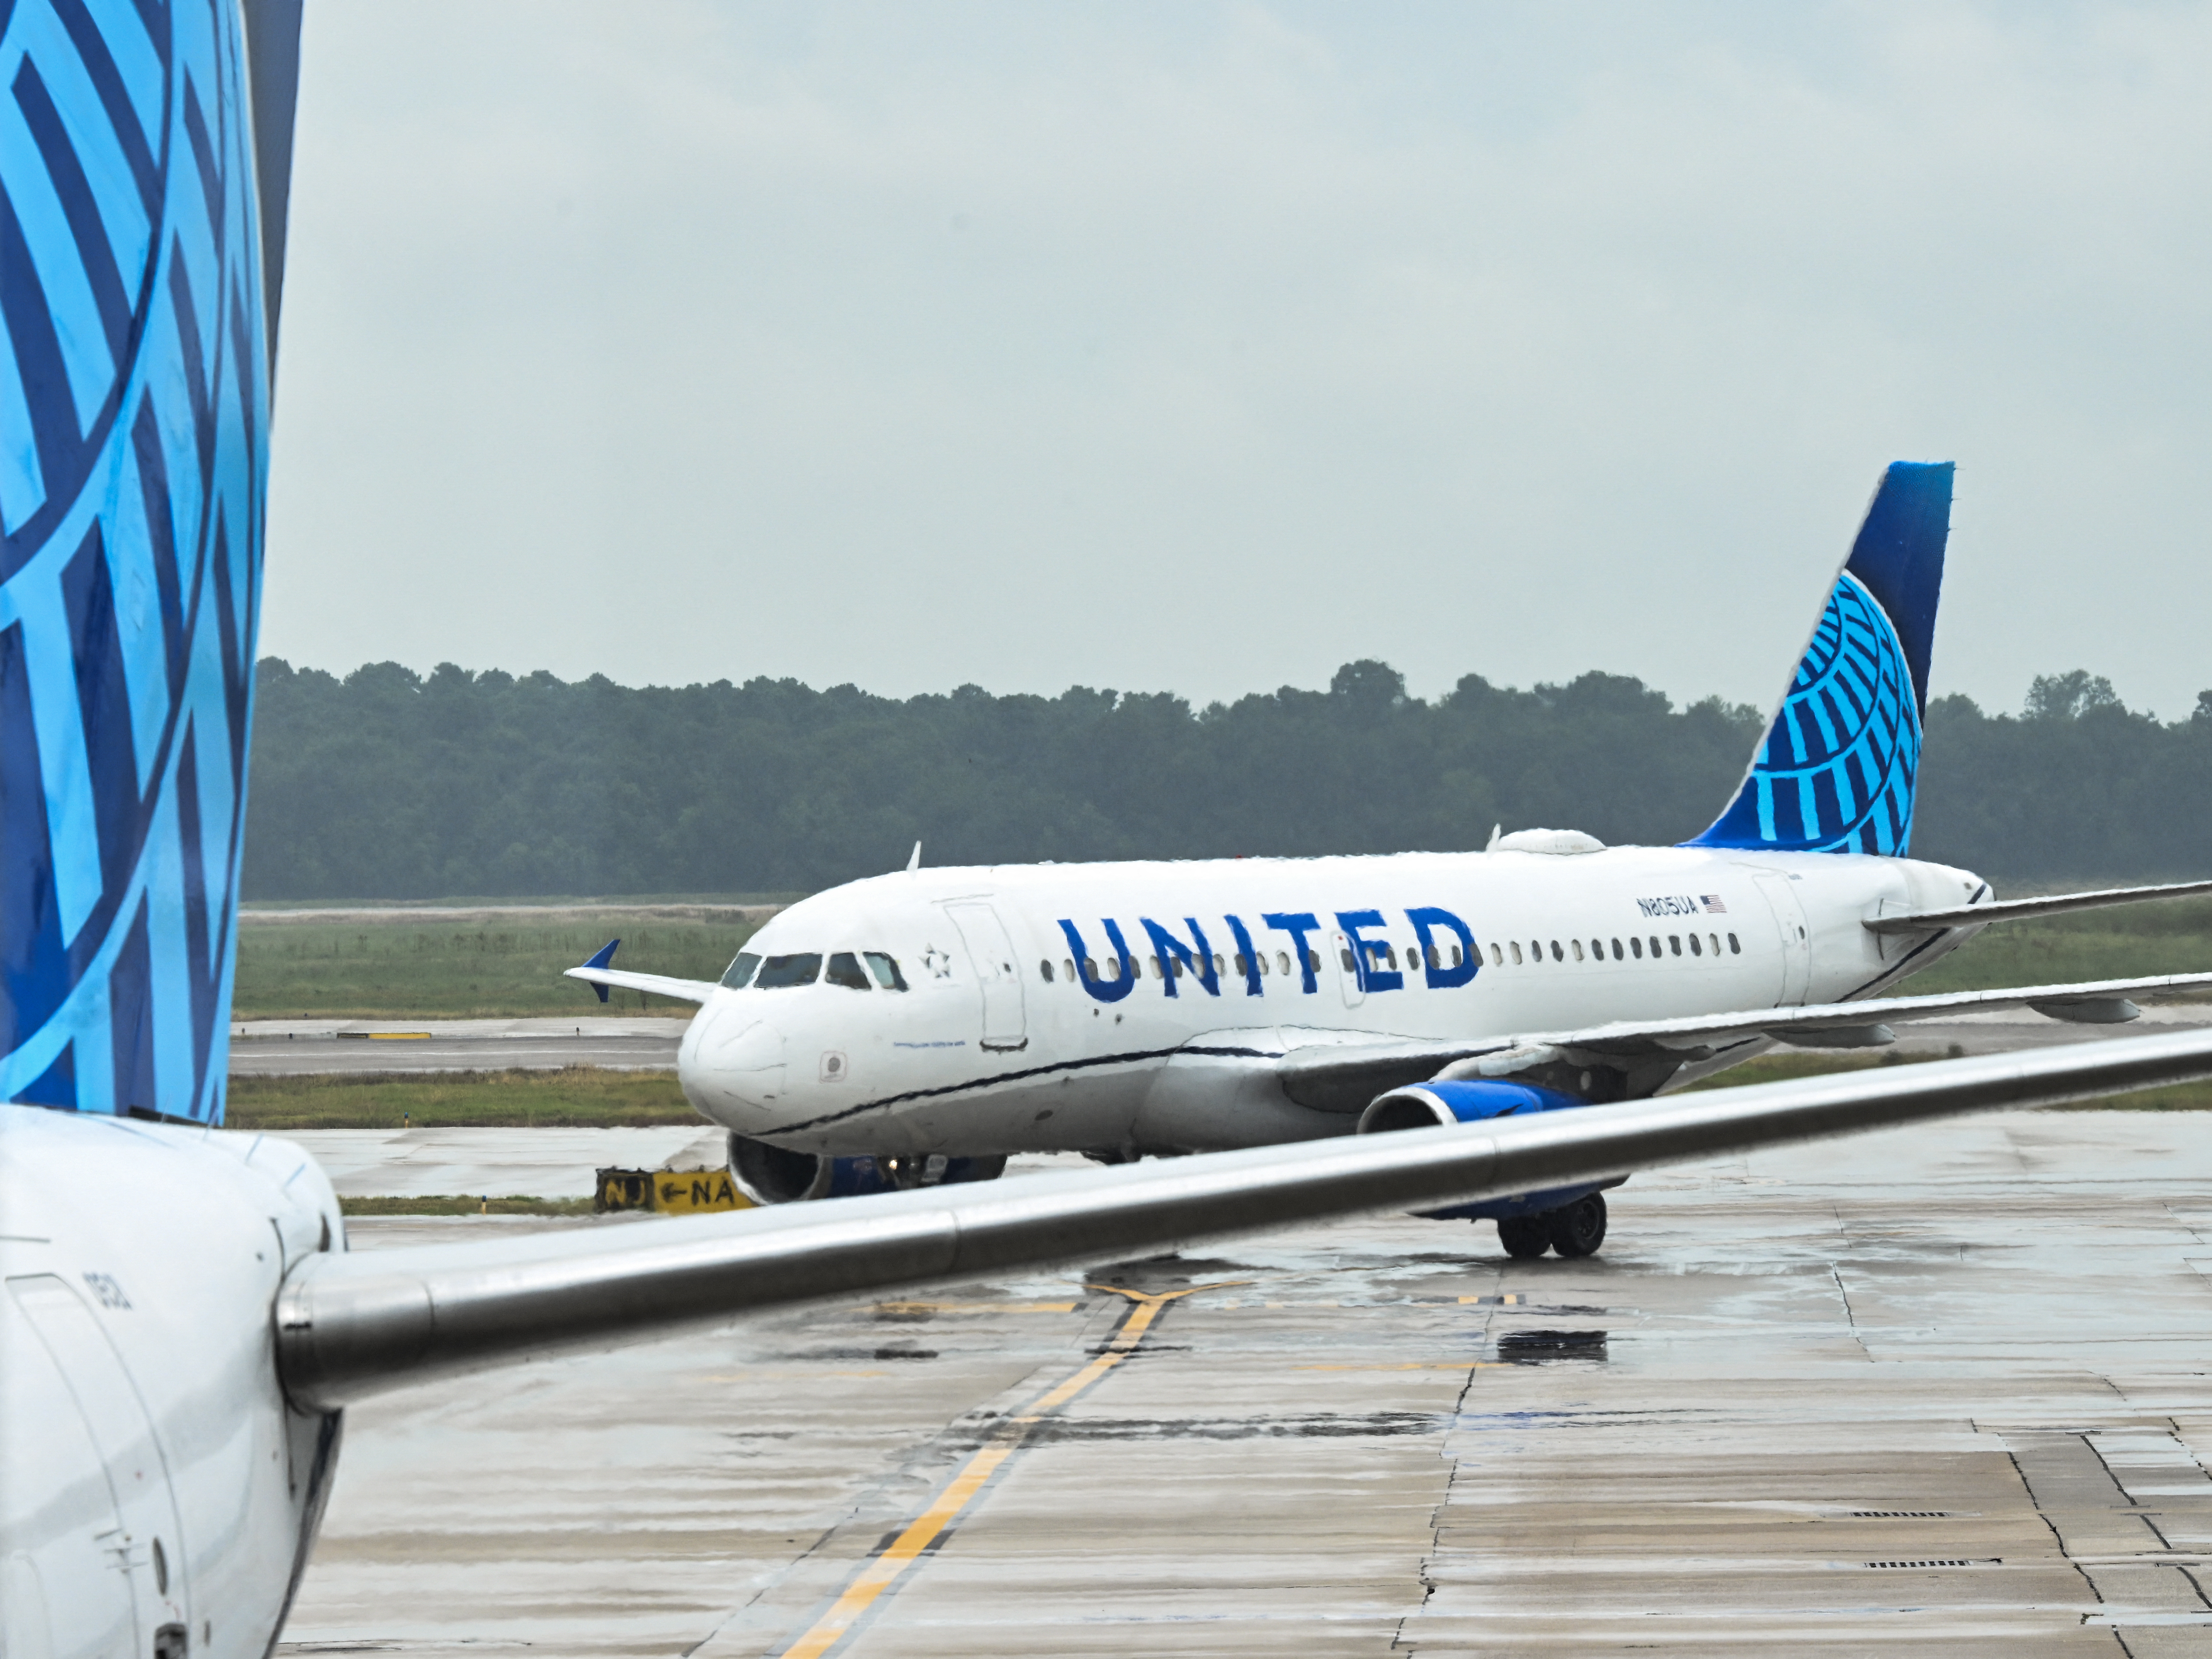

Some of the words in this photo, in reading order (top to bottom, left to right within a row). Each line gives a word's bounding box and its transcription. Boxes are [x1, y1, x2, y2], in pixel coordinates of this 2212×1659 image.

[1636, 895, 1699, 917] N805UA
[1057, 907, 1480, 1003] UNITED
[691, 1177, 733, 1205] NA
